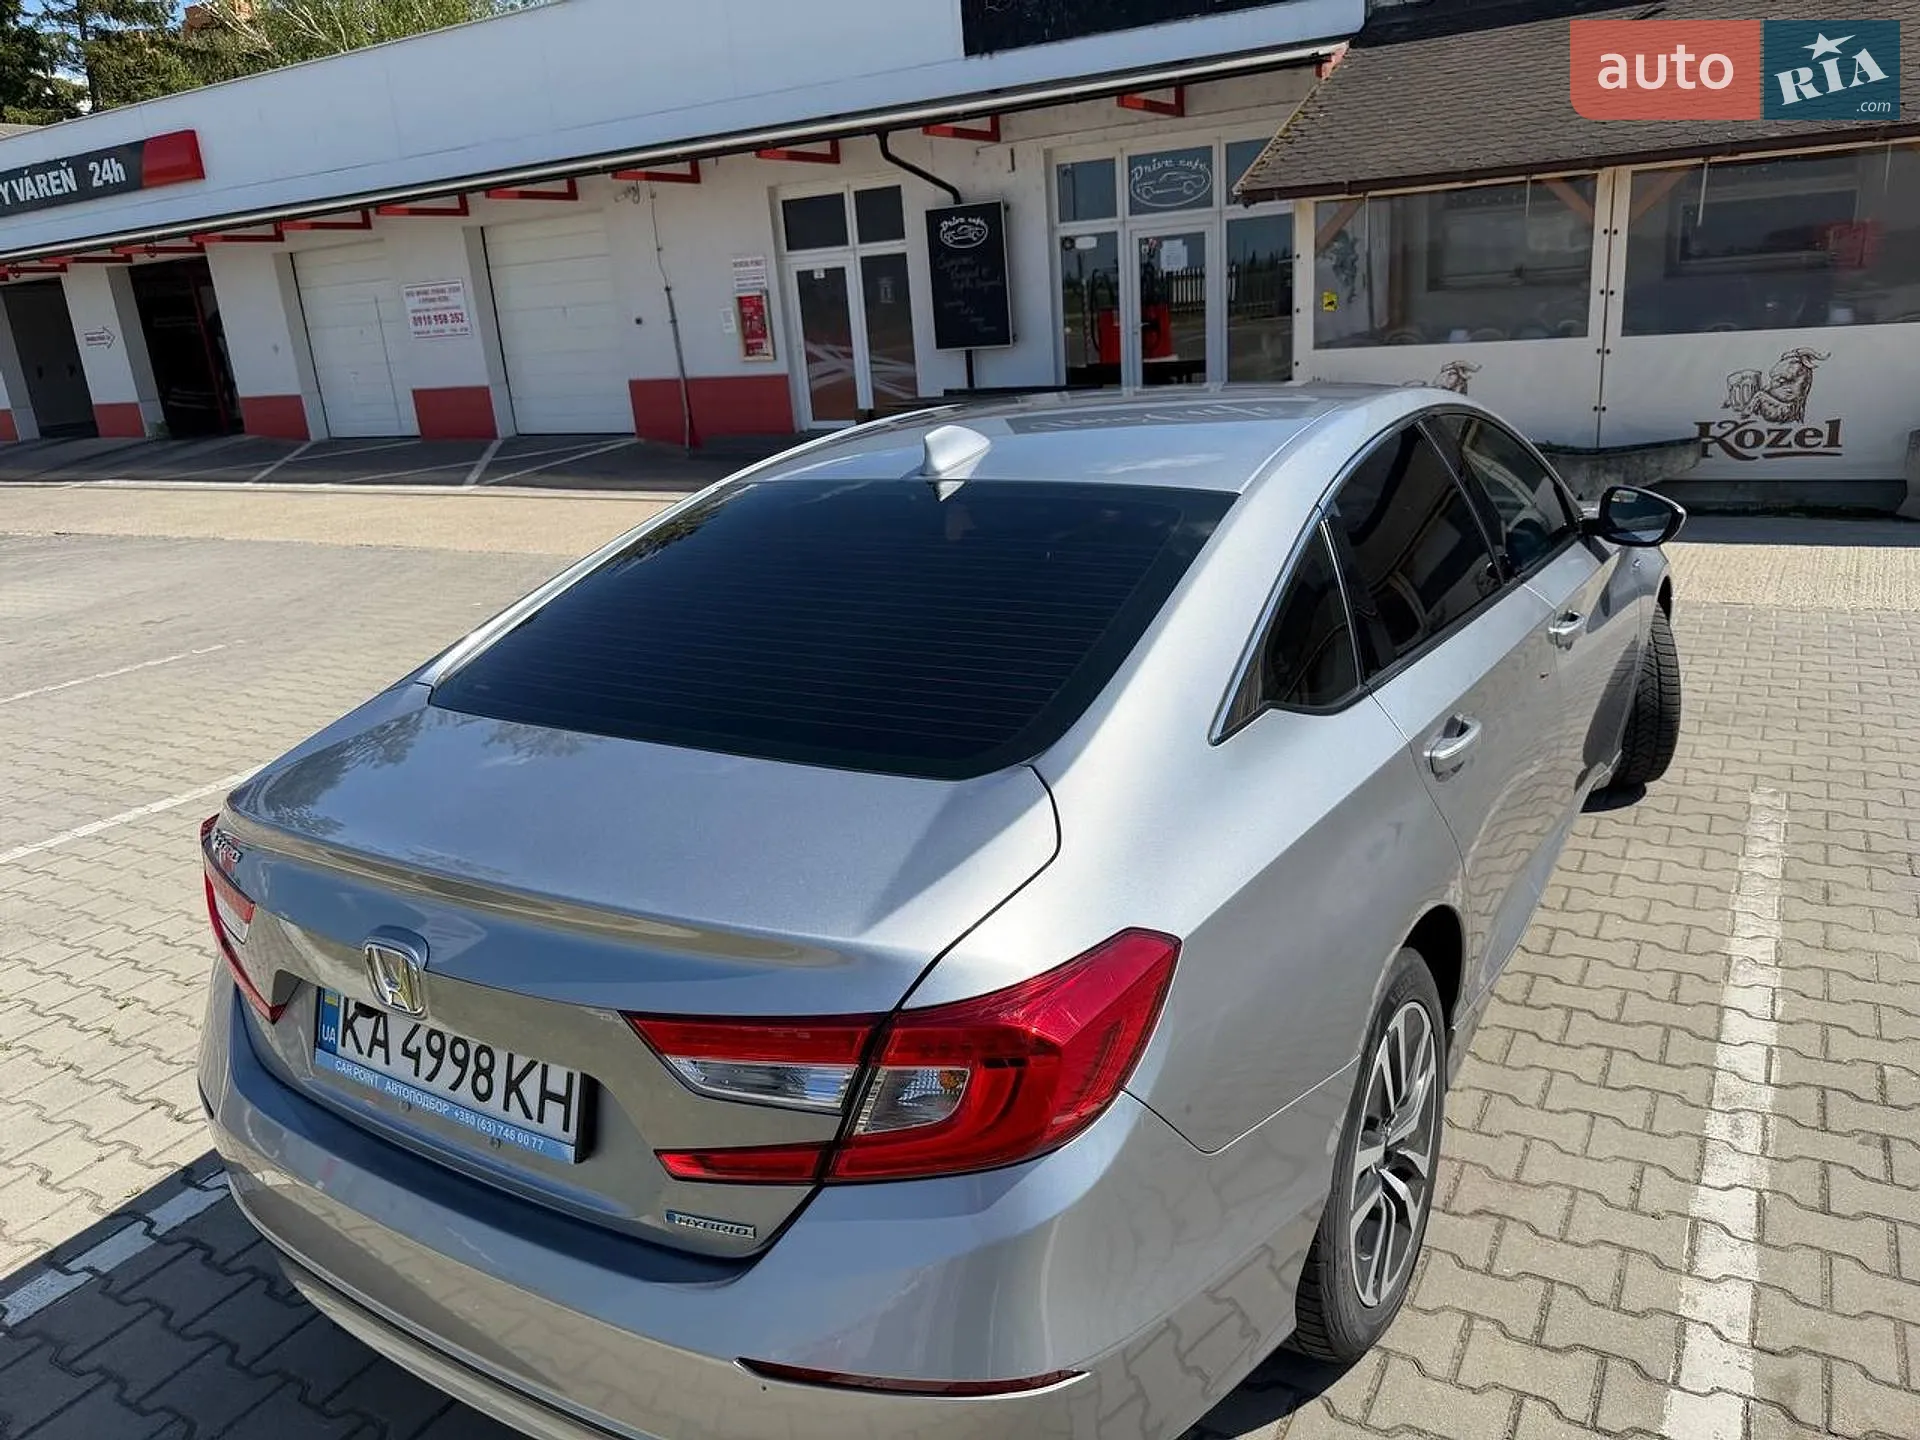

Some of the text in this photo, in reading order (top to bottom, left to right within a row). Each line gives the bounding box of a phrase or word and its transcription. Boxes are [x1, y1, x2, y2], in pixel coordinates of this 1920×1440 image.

[88, 157, 127, 188] 24h
[1694, 418, 1843, 462] Kozel
[322, 1023, 336, 1045] UA
[341, 996, 574, 1133] KA 4998 KH
[335, 1060, 353, 1078] CAR
[384, 1081, 450, 1114] АВТОПОДБОР
[517, 1131, 530, 1147] 00
[532, 1136, 545, 1151] 77
[676, 1213, 751, 1236] HYBRID
